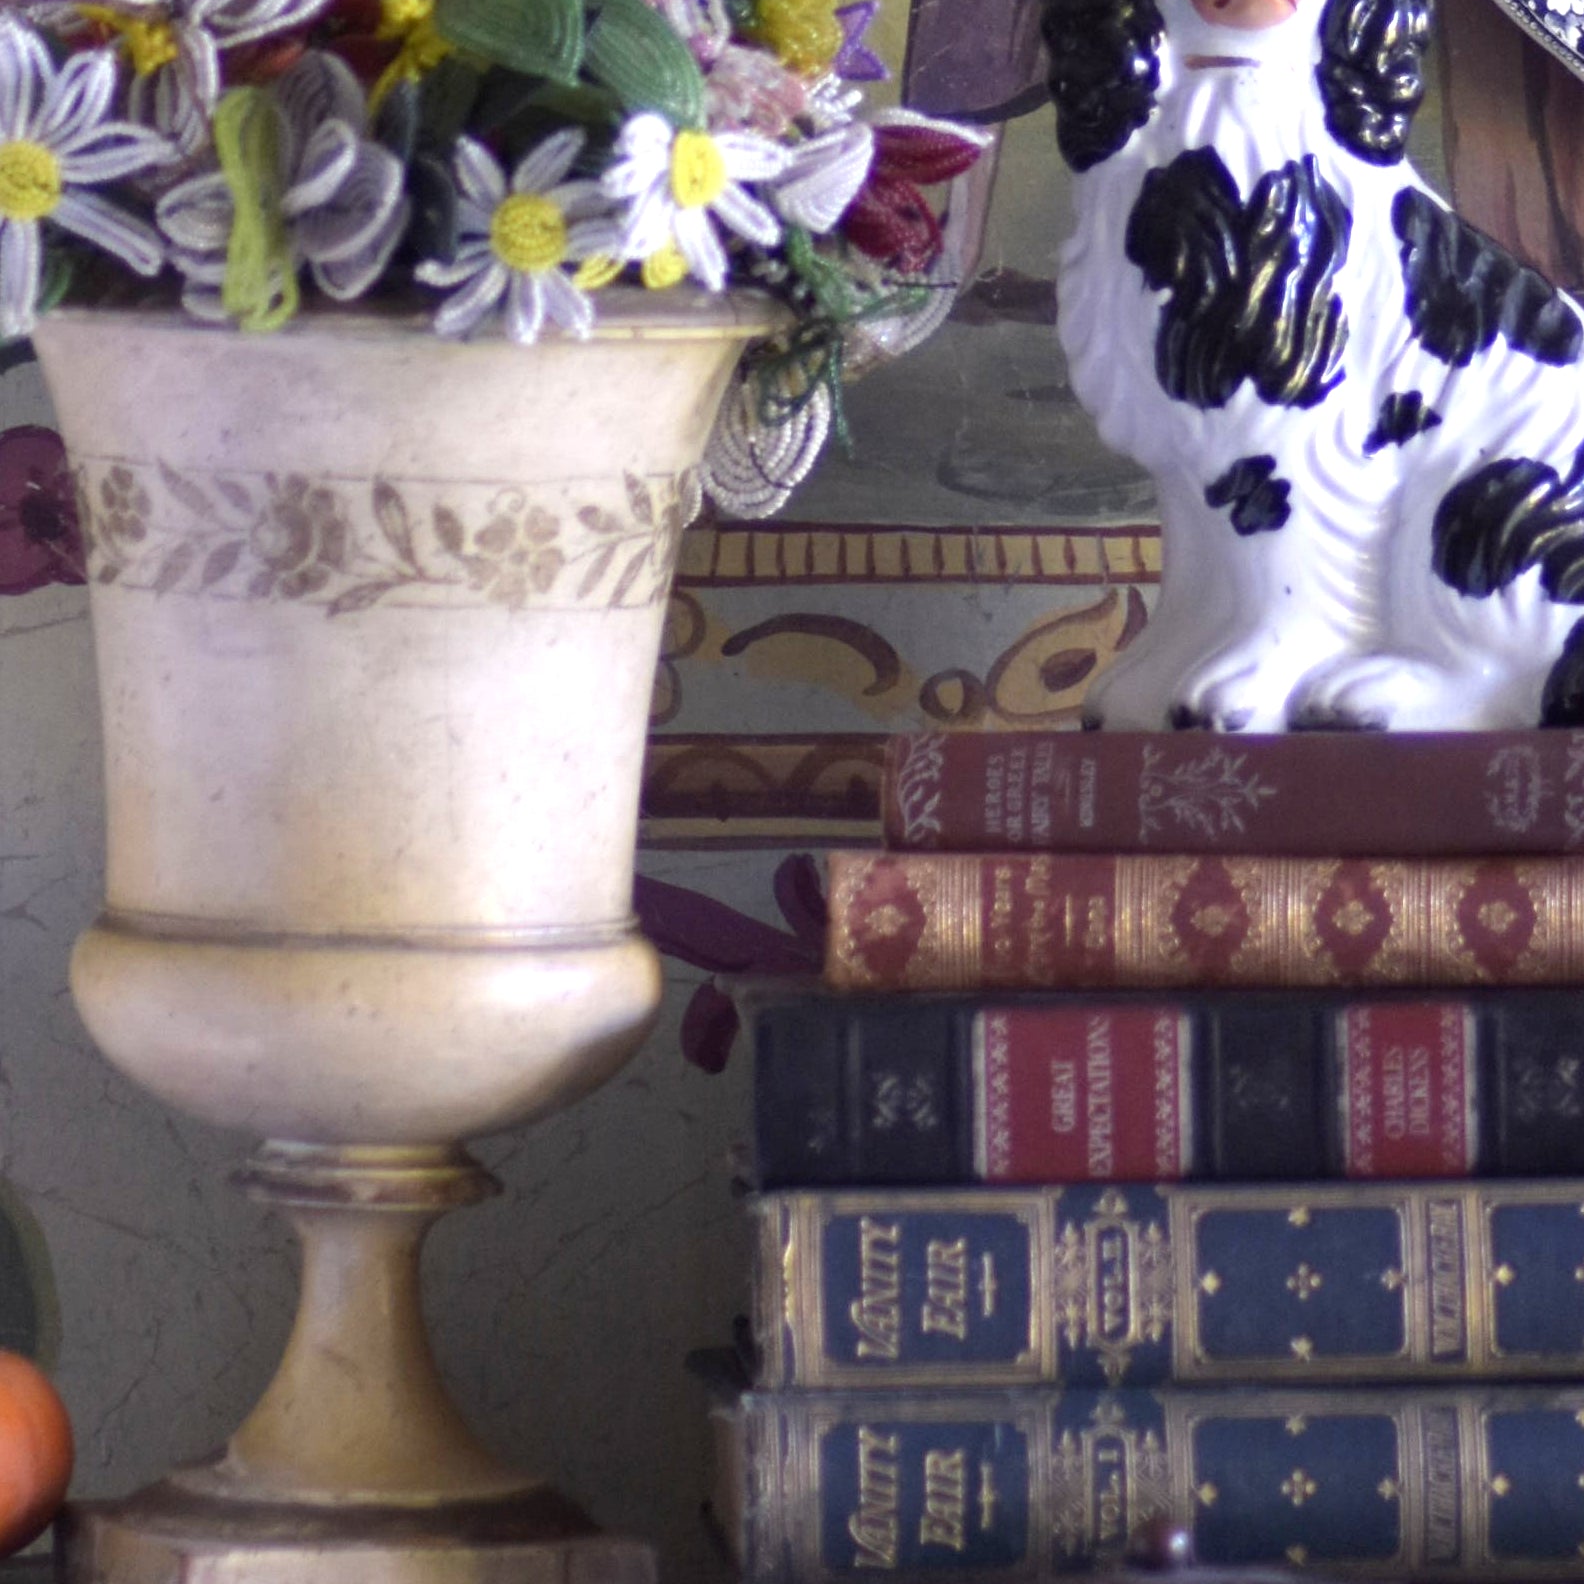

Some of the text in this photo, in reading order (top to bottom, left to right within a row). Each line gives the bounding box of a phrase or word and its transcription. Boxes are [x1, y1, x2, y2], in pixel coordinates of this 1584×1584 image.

[983, 753, 1005, 834] HEROES
[1005, 745, 1026, 843] OR GREEK
[1050, 1057, 1076, 1134] GREAT
[1086, 1013, 1113, 1178] EXPECTATIONS
[1382, 1044, 1405, 1141] CHARLES
[1407, 1045, 1430, 1136] DICKENS
[850, 1217, 899, 1357] VANITY
[922, 1238, 966, 1340] FAIR
[848, 1425, 898, 1568] VANITY
[920, 1449, 965, 1550] FAIR
[1097, 1470, 1121, 1541] VOL.
